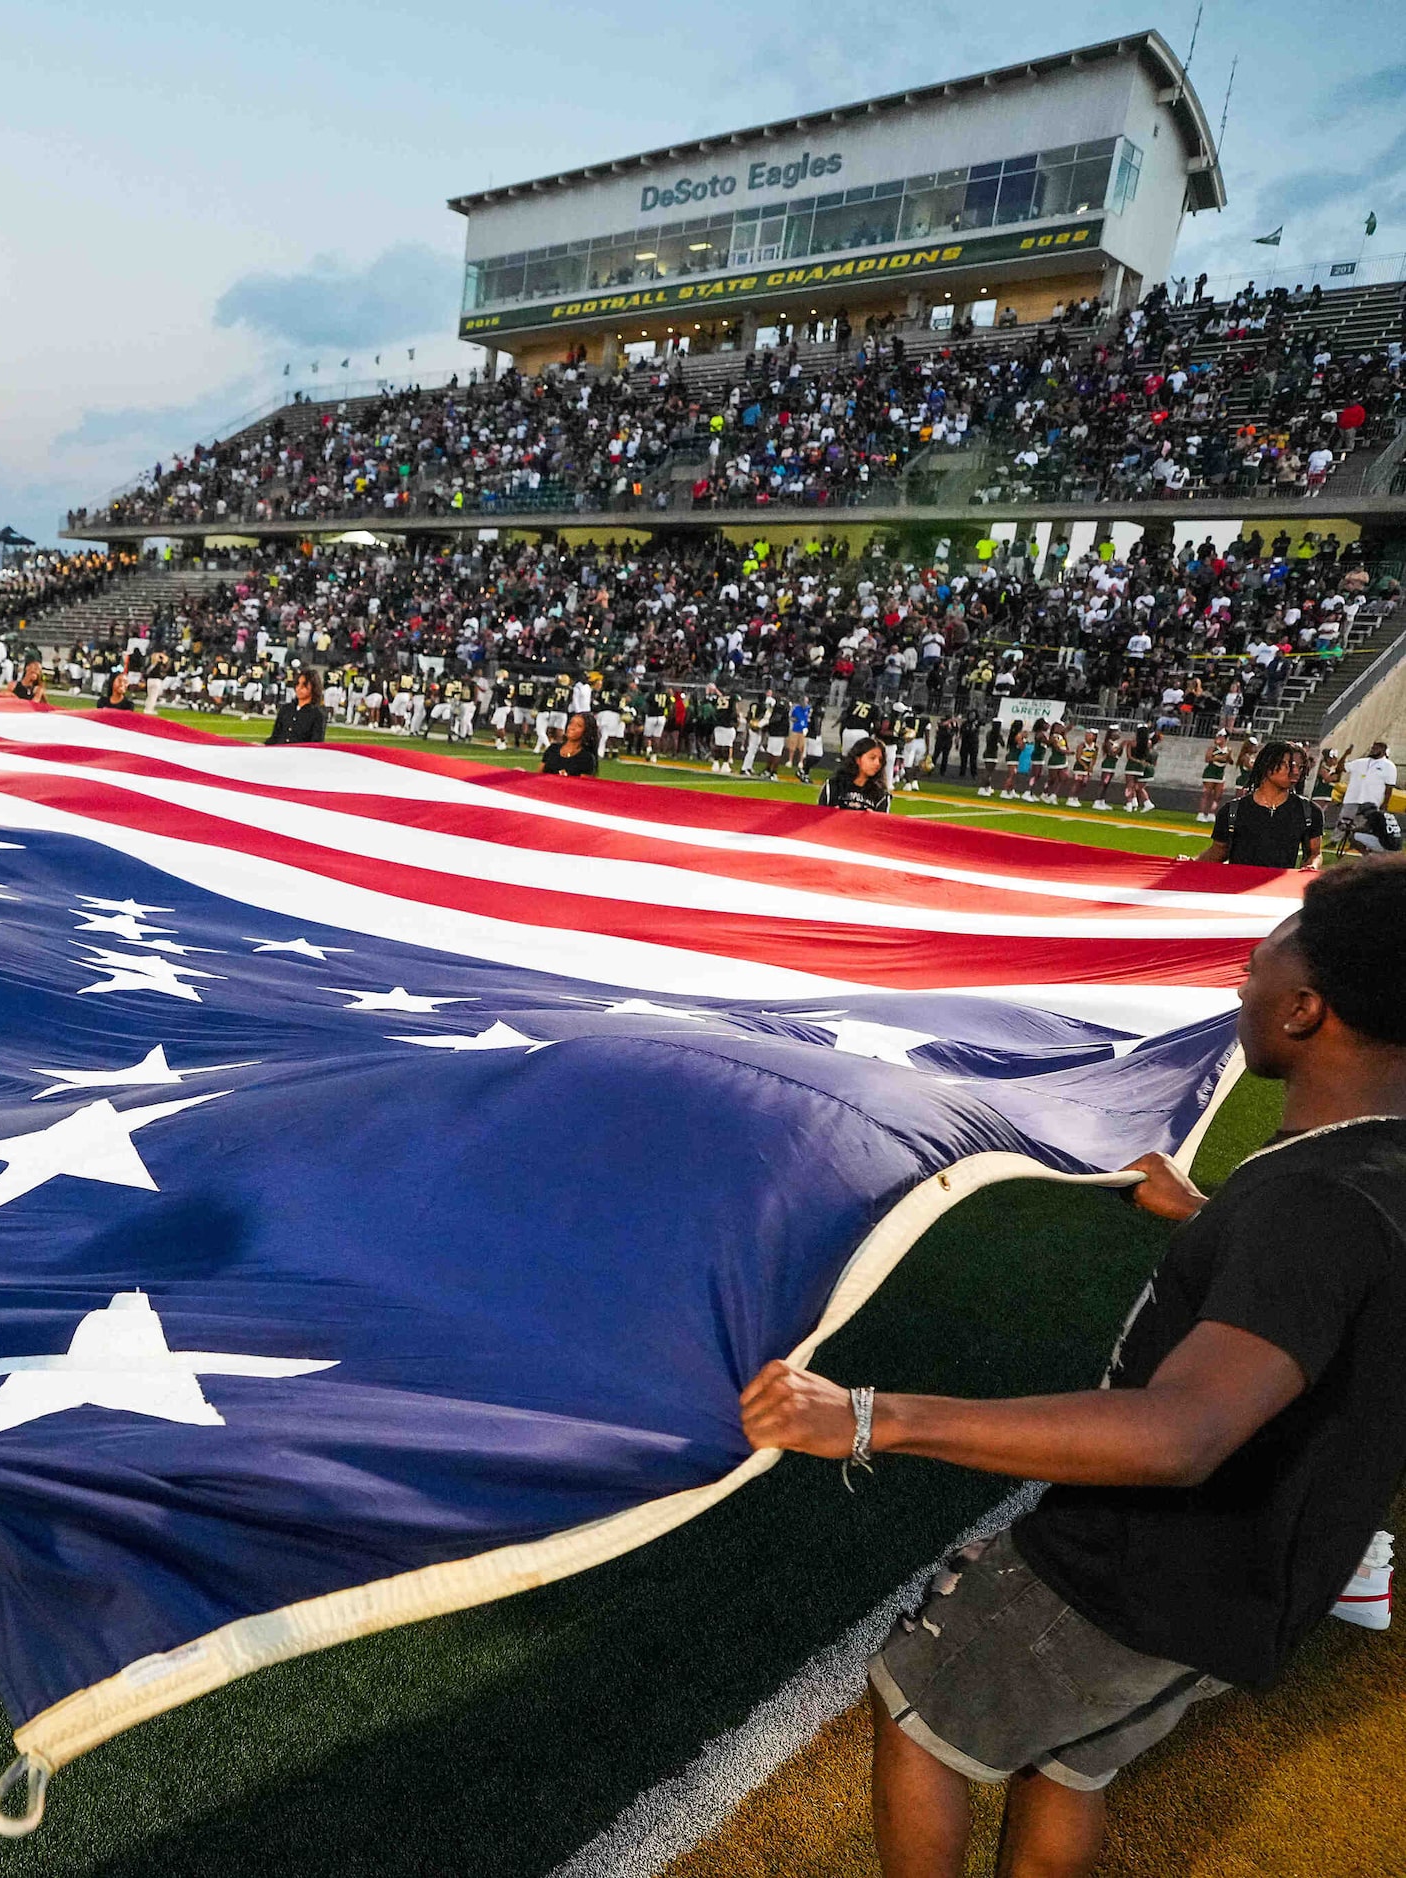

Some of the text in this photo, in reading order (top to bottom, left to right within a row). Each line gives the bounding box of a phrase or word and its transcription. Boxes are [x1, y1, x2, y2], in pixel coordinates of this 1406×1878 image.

[640, 151, 843, 212] DeSoto Eagles
[551, 291, 668, 319] FOOTBALL
[678, 276, 759, 300] STATE
[766, 246, 962, 285] CHAMPIONS
[852, 700, 872, 719] 76
[1011, 704, 1051, 717] GREEN
